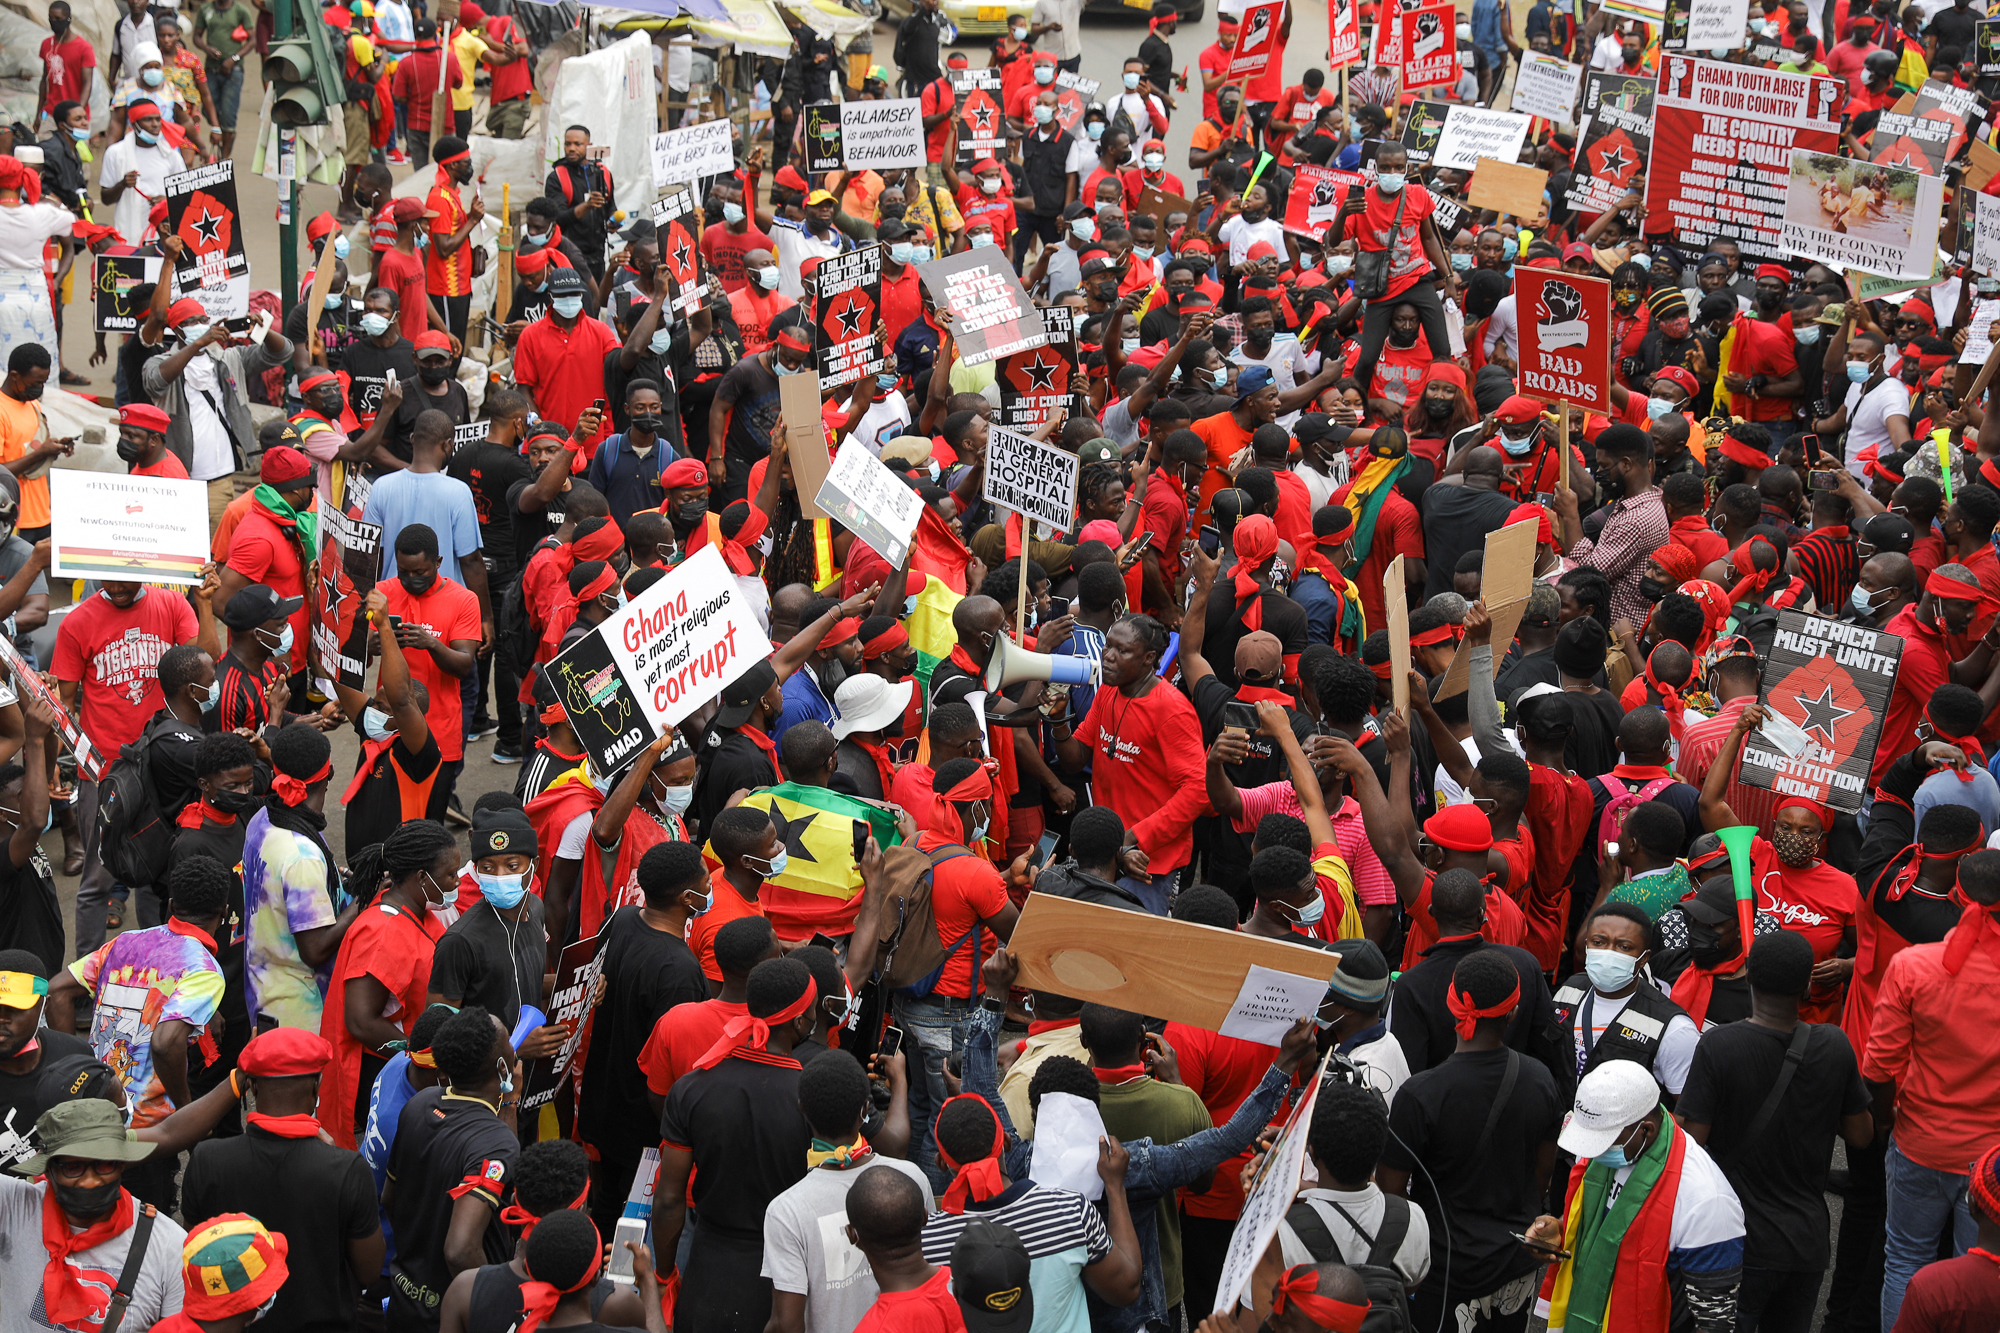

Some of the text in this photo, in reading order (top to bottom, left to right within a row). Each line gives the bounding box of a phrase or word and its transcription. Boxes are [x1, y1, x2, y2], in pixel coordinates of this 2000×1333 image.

[1333, 32, 1357, 51] BAD
[1231, 53, 1269, 69] CORRUPTION
[1405, 54, 1453, 74] KILLER
[954, 78, 1002, 91] MUST UNITE
[963, 69, 991, 81] AFRICA
[1407, 67, 1451, 85] RENTS
[1524, 62, 1576, 84] #FIXTHECOUNTRY
[1697, 65, 1806, 98] GHANA YOUTH ARISE
[1588, 78, 1600, 110] #MAD
[1700, 87, 1798, 118] FOR OUR COUNTRY
[1921, 85, 1988, 119] CONSTITUTION
[1944, 84, 1976, 101] A NEW
[844, 106, 915, 125] GALAMSEY
[1598, 111, 1633, 131] CAN YOU
[1600, 102, 1653, 128] HONOURABLE
[1939, 101, 1965, 118] NOW!
[1451, 111, 1523, 132] Stop installing
[1702, 113, 1797, 147] THE COUNTRY
[1806, 120, 1832, 131] FREEDOM
[1877, 122, 1949, 144] GOLD MONEY?
[1880, 111, 1952, 134] WHERE IS OUR
[656, 123, 728, 152] WE DESERVE
[847, 126, 915, 142] is unpatriotic
[959, 138, 1007, 150] CONSTITUTION
[978, 129, 993, 139] NEW
[1450, 126, 1516, 143] foreigners as
[849, 144, 917, 161] BEHAVIOUR
[1457, 140, 1499, 152] traditional
[1692, 133, 1736, 161] NEEDS
[661, 147, 708, 169] THE BEST
[814, 158, 839, 169] #MAD
[1691, 158, 1756, 180] ENOUGH OF THE
[165, 159, 233, 188] ACCOUNTABILITY
[167, 170, 232, 197] IN GOVERNMENT
[1300, 166, 1361, 185] #FIXTHECOUNTRY
[1575, 173, 1611, 191] ON 700
[1679, 171, 1743, 194] ENOUGH OF THE
[1576, 183, 1593, 196] PER
[1681, 186, 1745, 209] ENOUGH OF THE
[1668, 199, 1762, 227] ENOUGH OF THE POLICE
[1674, 215, 1758, 242] THE POLICE AND THE
[1680, 230, 1793, 263] NEEDS TRANSPARENT
[1784, 224, 1907, 261] FIX THE COUNTRY
[196, 249, 225, 267] A NEW
[827, 247, 879, 272] BILLION PER
[1783, 237, 1905, 276] MR. PRESIDENT
[179, 254, 245, 284] CONSTITUTION
[202, 274, 226, 287] NOW!
[819, 258, 880, 287] YEAR LOST TO
[945, 264, 990, 286] PARTY
[822, 272, 877, 298] CORRUPTION
[944, 273, 1006, 300] POLITICS
[1873, 280, 1892, 292] TIME
[950, 285, 1011, 311] DEY KILL
[962, 297, 1012, 320] WANNA
[104, 316, 137, 328] #MAD
[961, 306, 1022, 334] COUNTRY
[1047, 307, 1068, 320] PER
[1057, 319, 1072, 331] TO
[848, 333, 876, 352] COURT
[964, 332, 1046, 366] #FIXTHECOUNTRY
[829, 347, 874, 373] BUSY WITH
[1539, 352, 1582, 376] BAD
[820, 358, 884, 390] CASSAVA THIEF
[1524, 370, 1597, 401] ROADS
[1039, 394, 1075, 408] COURT
[1012, 408, 1041, 423] BUSY
[992, 430, 1074, 475] BRING BACK
[991, 446, 1071, 489] LA GENERAL
[86, 482, 180, 497] #FIXTHECOUNTRY
[990, 461, 1069, 506] HOSPITAL
[996, 482, 1069, 527] FIX THE COUNTRY
[112, 550, 159, 559] #AriseGhanaYouth
[623, 589, 688, 653] Ghana
[634, 590, 731, 671] is most religious
[105, 633, 160, 652] 2014 NCAA
[326, 626, 340, 647] NEW
[1803, 616, 1878, 651] AFRICA
[313, 624, 363, 677] CONSTITUTION
[1773, 629, 1898, 677] MUST UNITE
[321, 652, 337, 679] NOW!
[583, 662, 616, 692] MOVEMENT
[644, 641, 691, 693] yet most
[654, 620, 737, 712] corrupt
[106, 671, 135, 687] FINAL
[591, 678, 623, 705] DISORDER
[600, 691, 617, 708] (MAD)
[603, 727, 644, 766] #MAD
[1116, 736, 1141, 755] Santa
[1742, 747, 1866, 793] CONSTITUTION
[1775, 776, 1820, 800] NOW!
[1757, 870, 1829, 926] Super
[1254, 994, 1289, 1004] NABCO
[1265, 985, 1287, 994] #FIX
[1239, 1010, 1300, 1023] PERMANENT
[1246, 1003, 1296, 1014] TRAINEEZ
[69, 1071, 89, 1095] GUCCI
[394, 1272, 428, 1302] unicef
[826, 1276, 854, 1291] BIGGER
